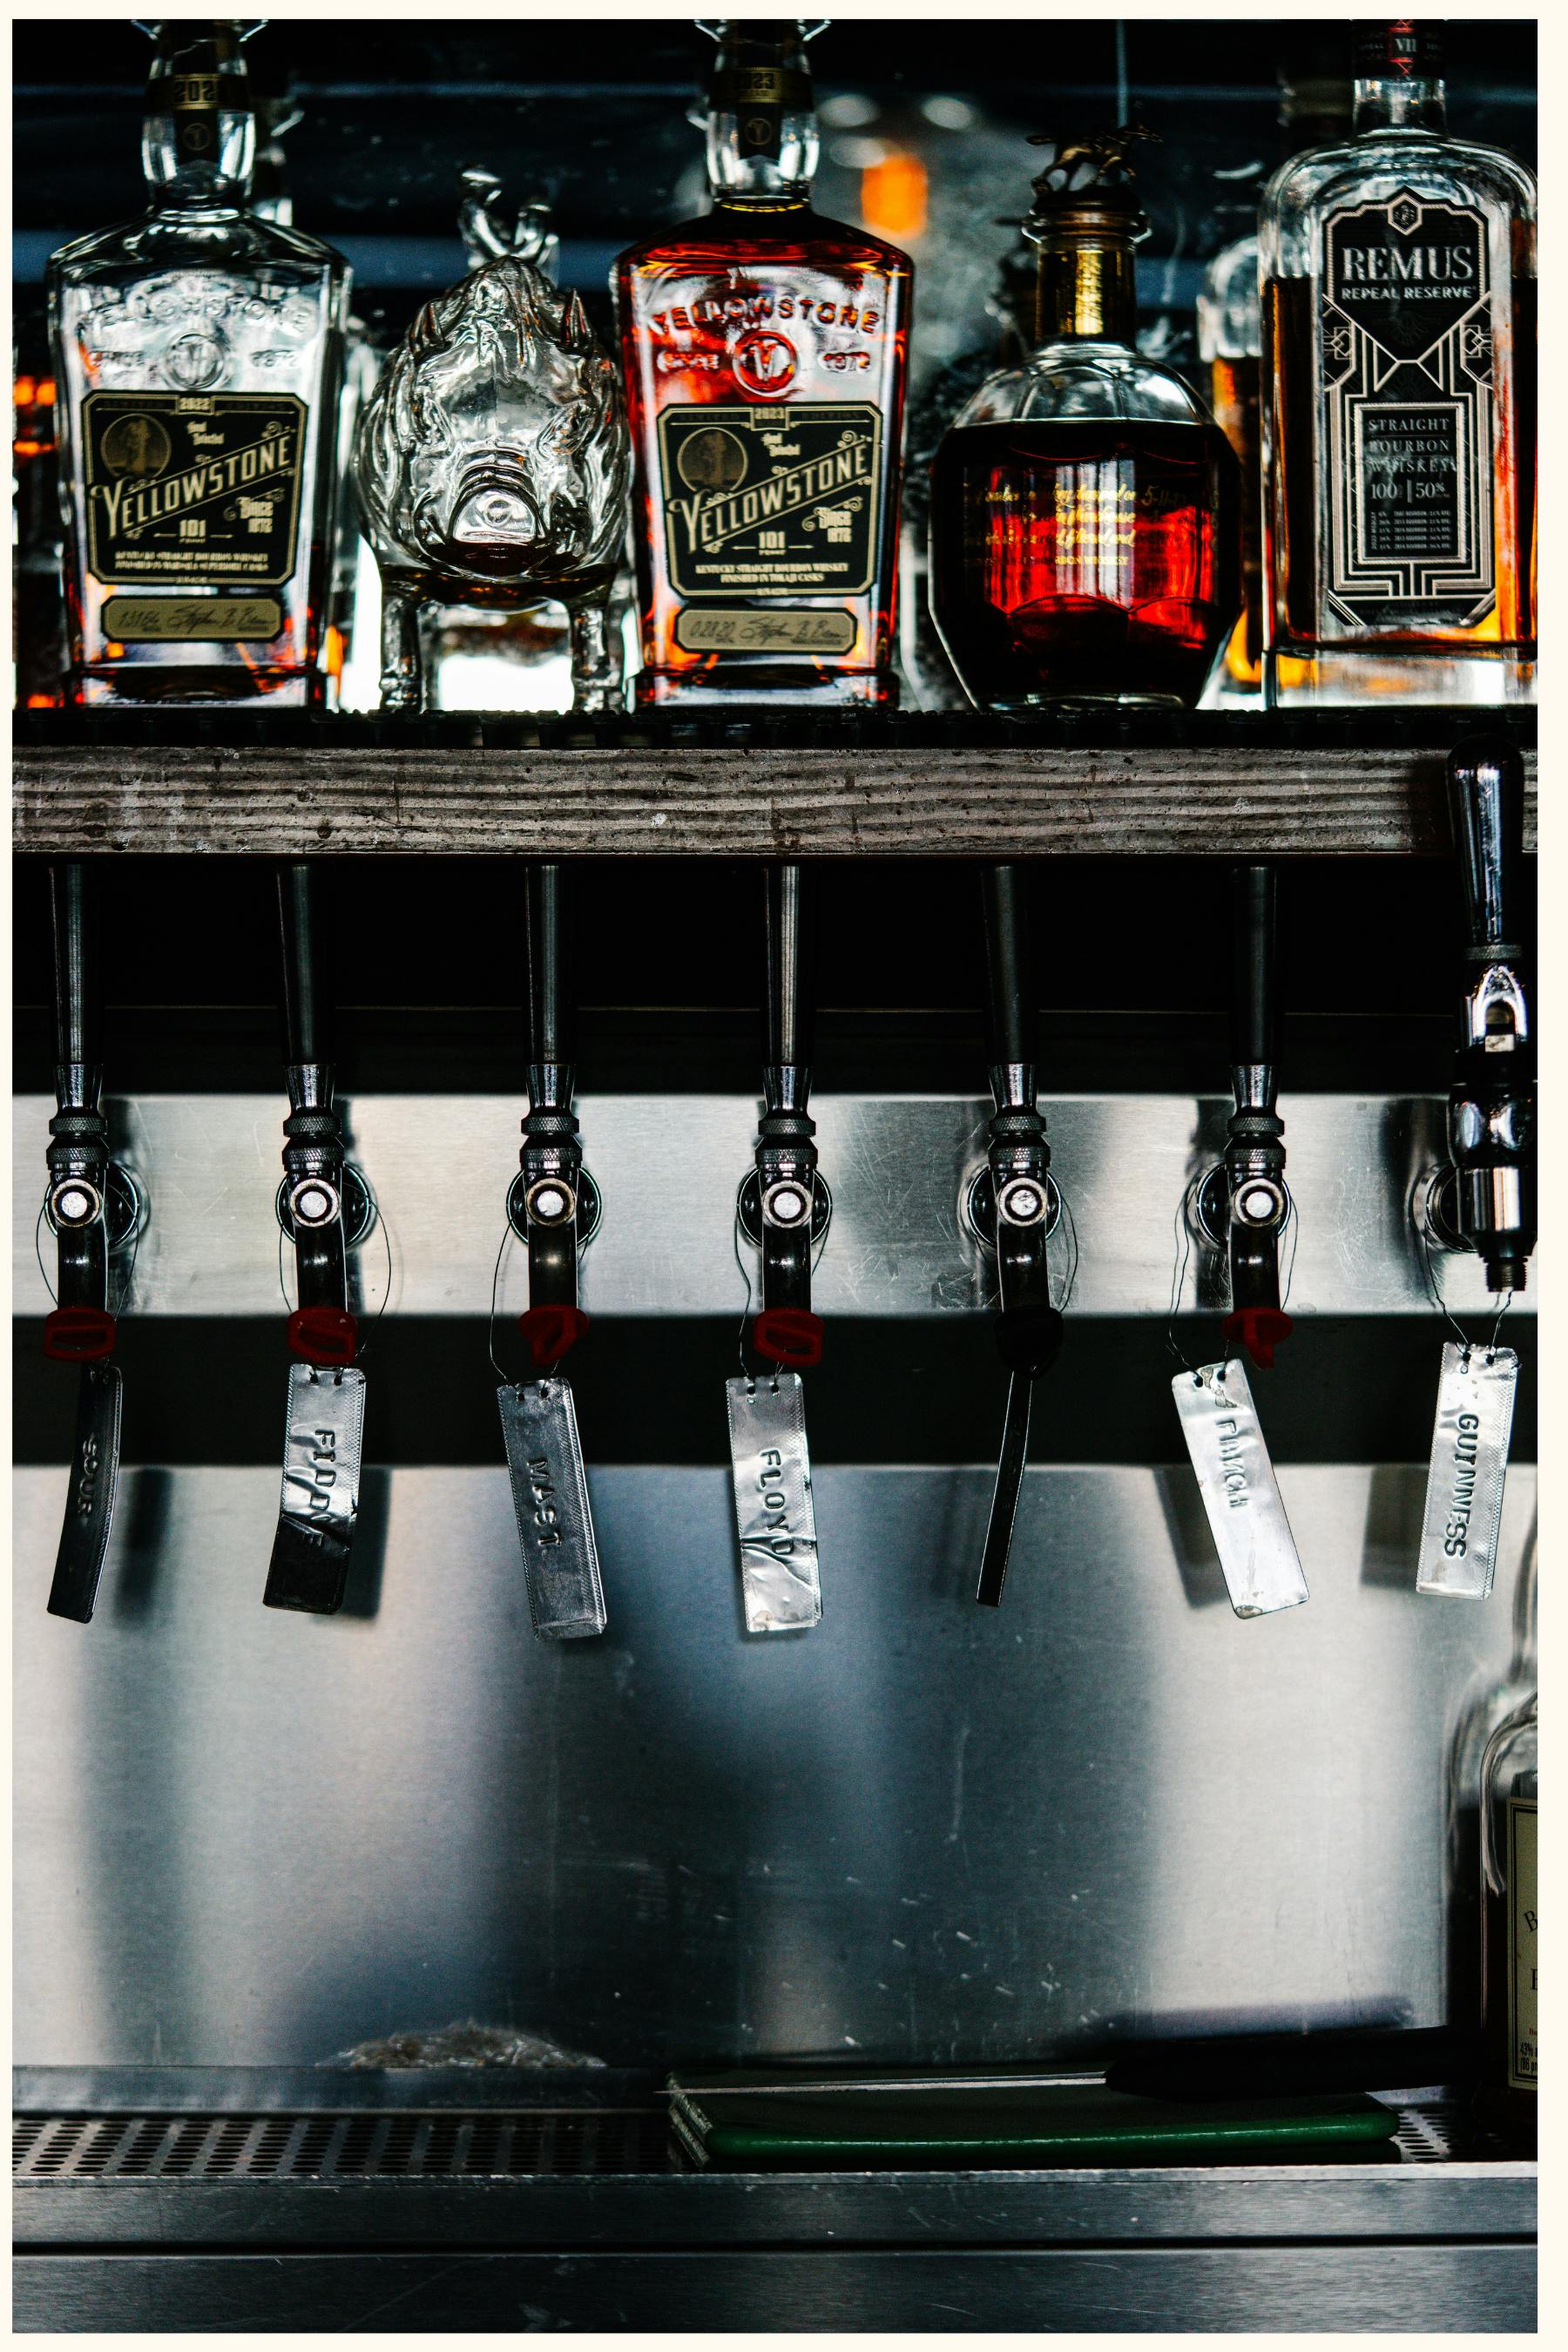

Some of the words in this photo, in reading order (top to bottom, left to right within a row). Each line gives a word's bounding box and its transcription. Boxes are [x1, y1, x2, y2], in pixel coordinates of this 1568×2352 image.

[1395, 38, 1417, 52] VII
[1342, 247, 1474, 280] REMUS
[1342, 287, 1401, 301] REPEAL
[1403, 286, 1473, 300] RESERVE
[646, 297, 881, 335] YELLOWSTONE
[179, 398, 210, 410] 2022
[754, 407, 785, 420] 2023
[1368, 418, 1450, 432] STRAIGHT
[1368, 439, 1450, 453] BOURBON
[1369, 458, 1451, 473] WHISKEY
[90, 436, 293, 542] YELLOWSTONE
[1370, 482, 1398, 501] 100
[1416, 482, 1447, 499] 50%
[668, 444, 868, 556] YELLOWSTONE
[179, 520, 206, 537] 101
[759, 531, 787, 549] 101
[737, 564, 774, 573] STRAIGHT
[813, 563, 848, 572] WHISKEY
[1443, 1414, 1479, 1558] GUINNESS
[759, 1449, 794, 1556] FLOYD
